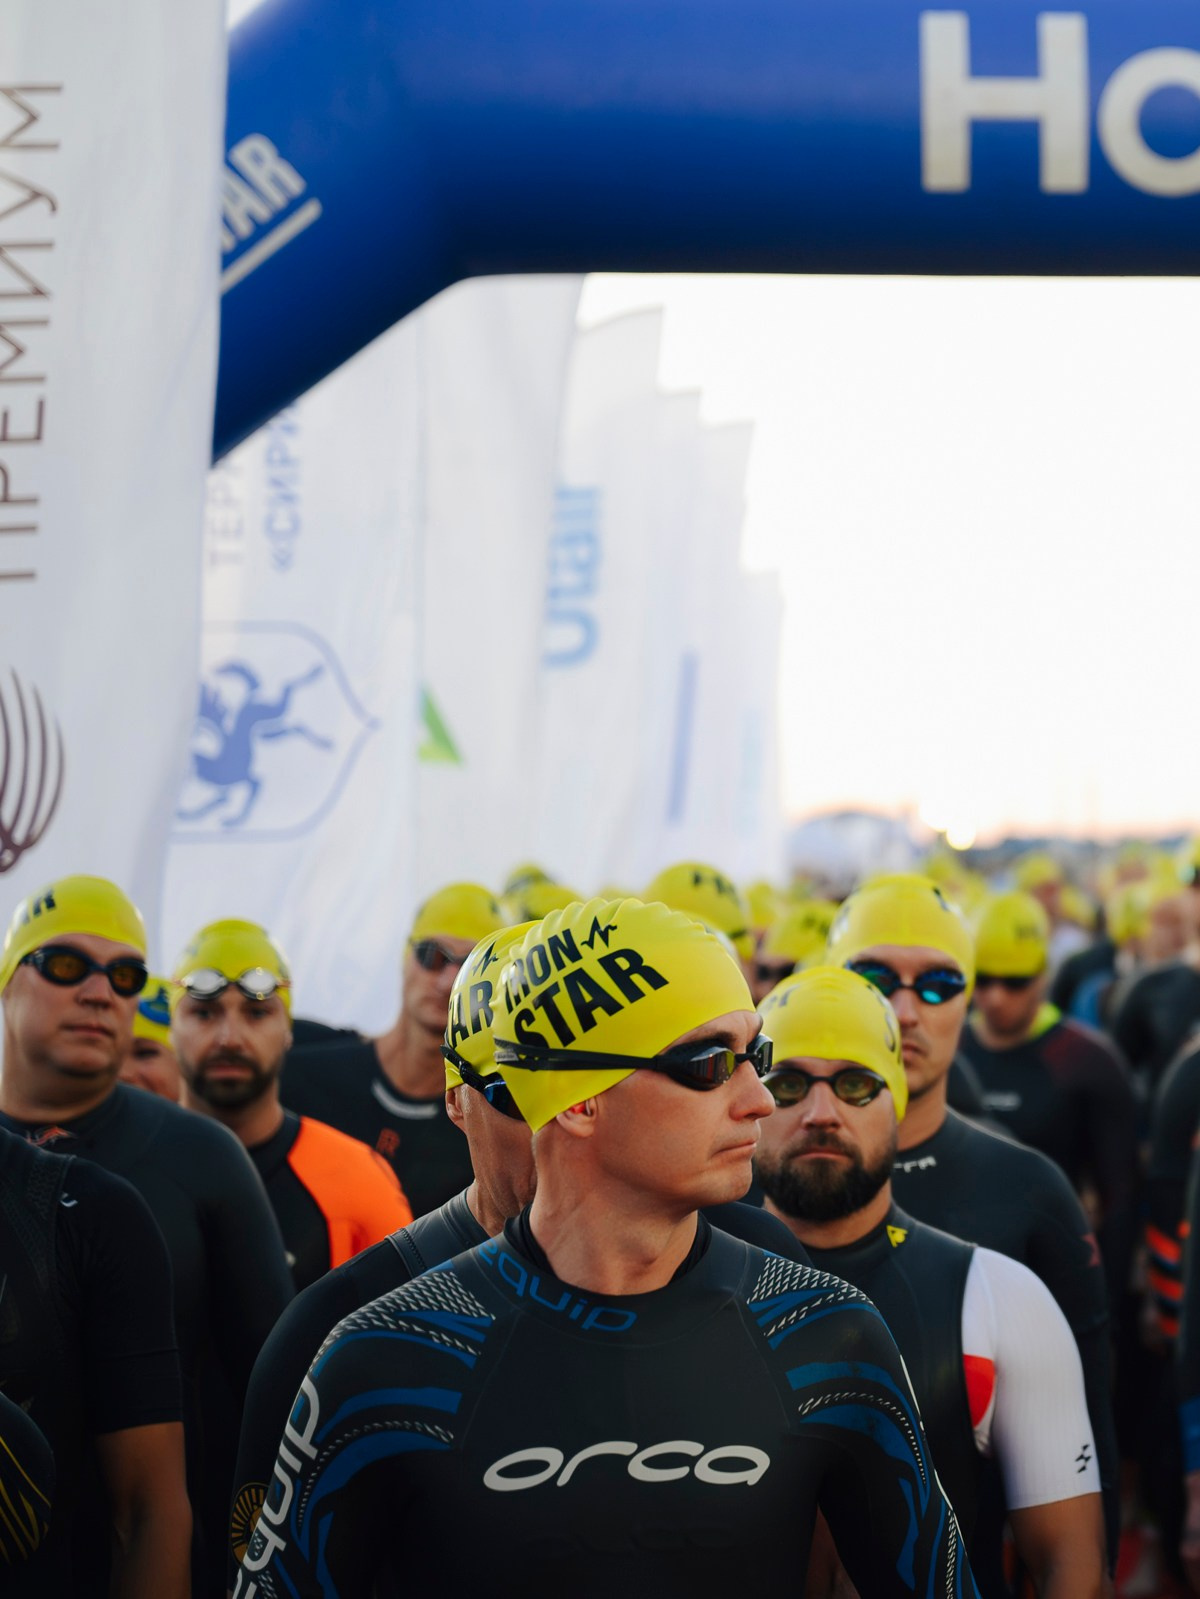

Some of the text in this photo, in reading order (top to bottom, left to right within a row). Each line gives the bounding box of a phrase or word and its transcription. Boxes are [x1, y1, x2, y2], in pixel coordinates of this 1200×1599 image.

[221, 132, 308, 255] AR
[449, 980, 494, 1050] AR
[504, 928, 583, 1015] IRON
[514, 948, 670, 1050] STAR
[478, 1238, 638, 1332] equip
[483, 1440, 771, 1492] orca
